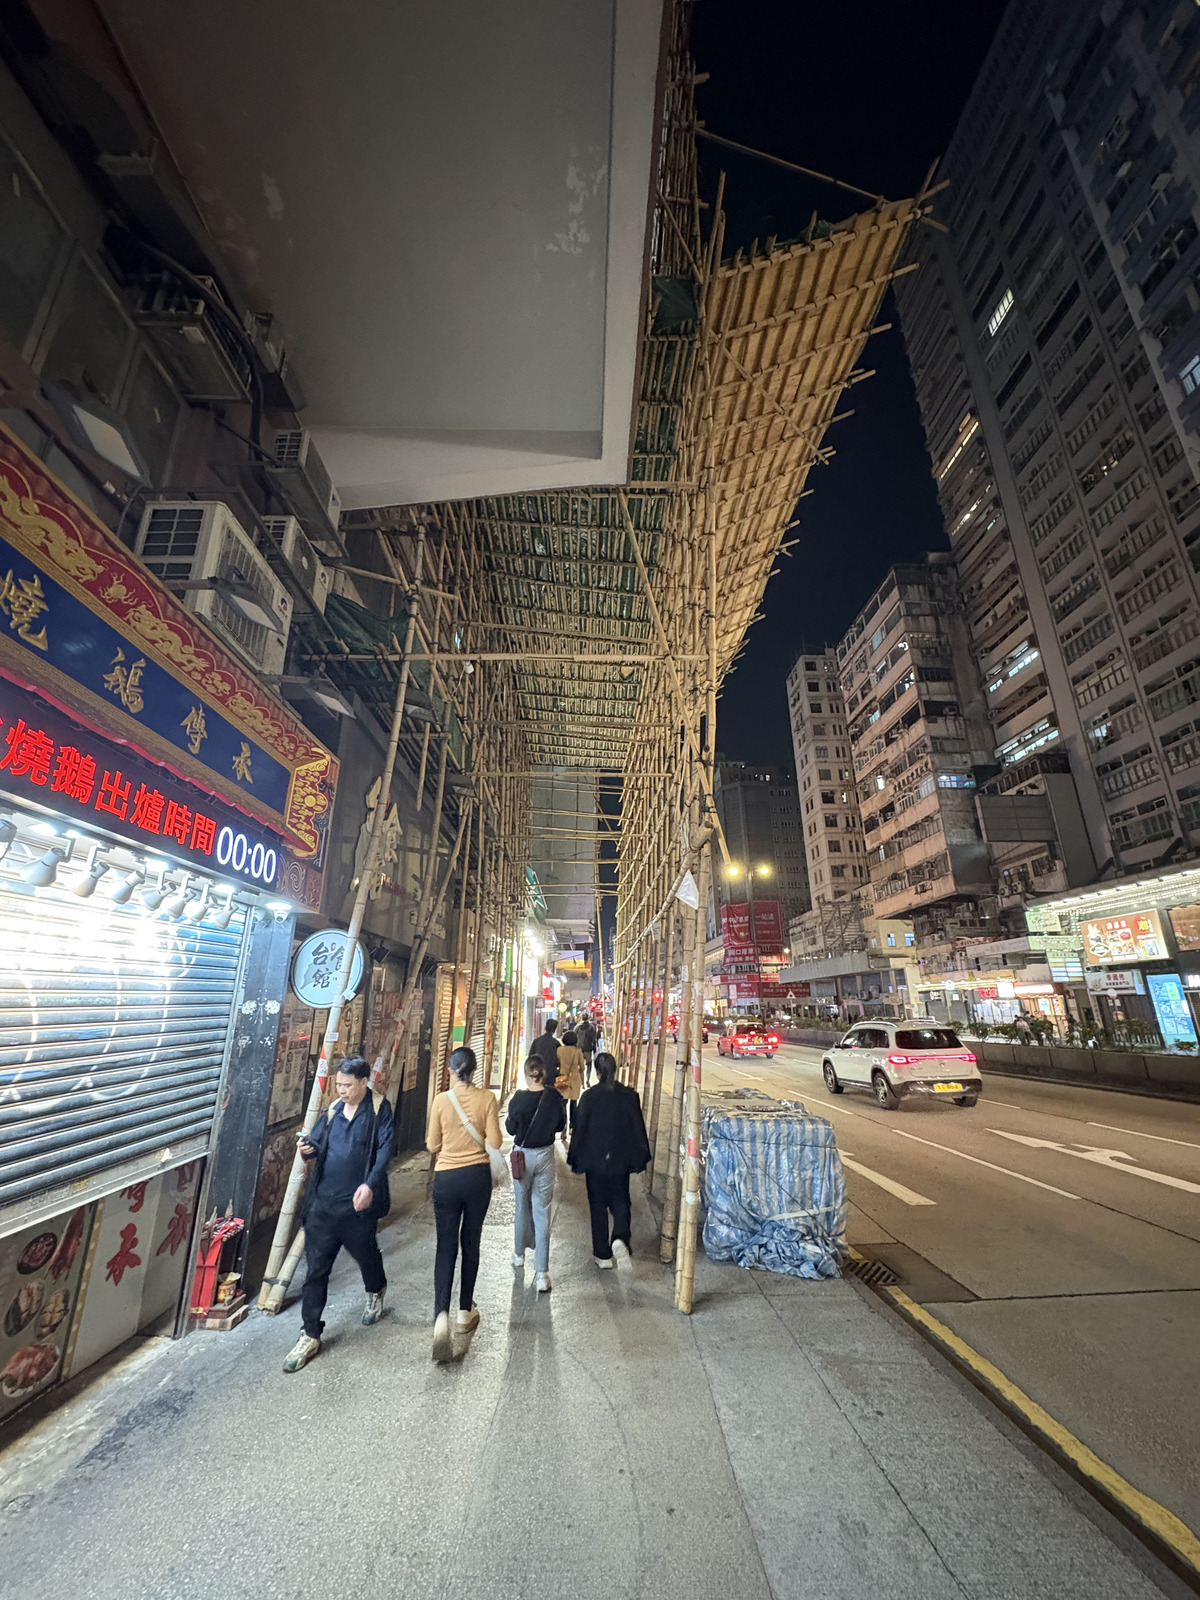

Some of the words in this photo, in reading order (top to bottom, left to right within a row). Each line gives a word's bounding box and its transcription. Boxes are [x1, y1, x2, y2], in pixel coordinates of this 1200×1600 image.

[0, 715, 217, 856] 燒鵝出爐時間
[216, 826, 277, 883] 00:00
